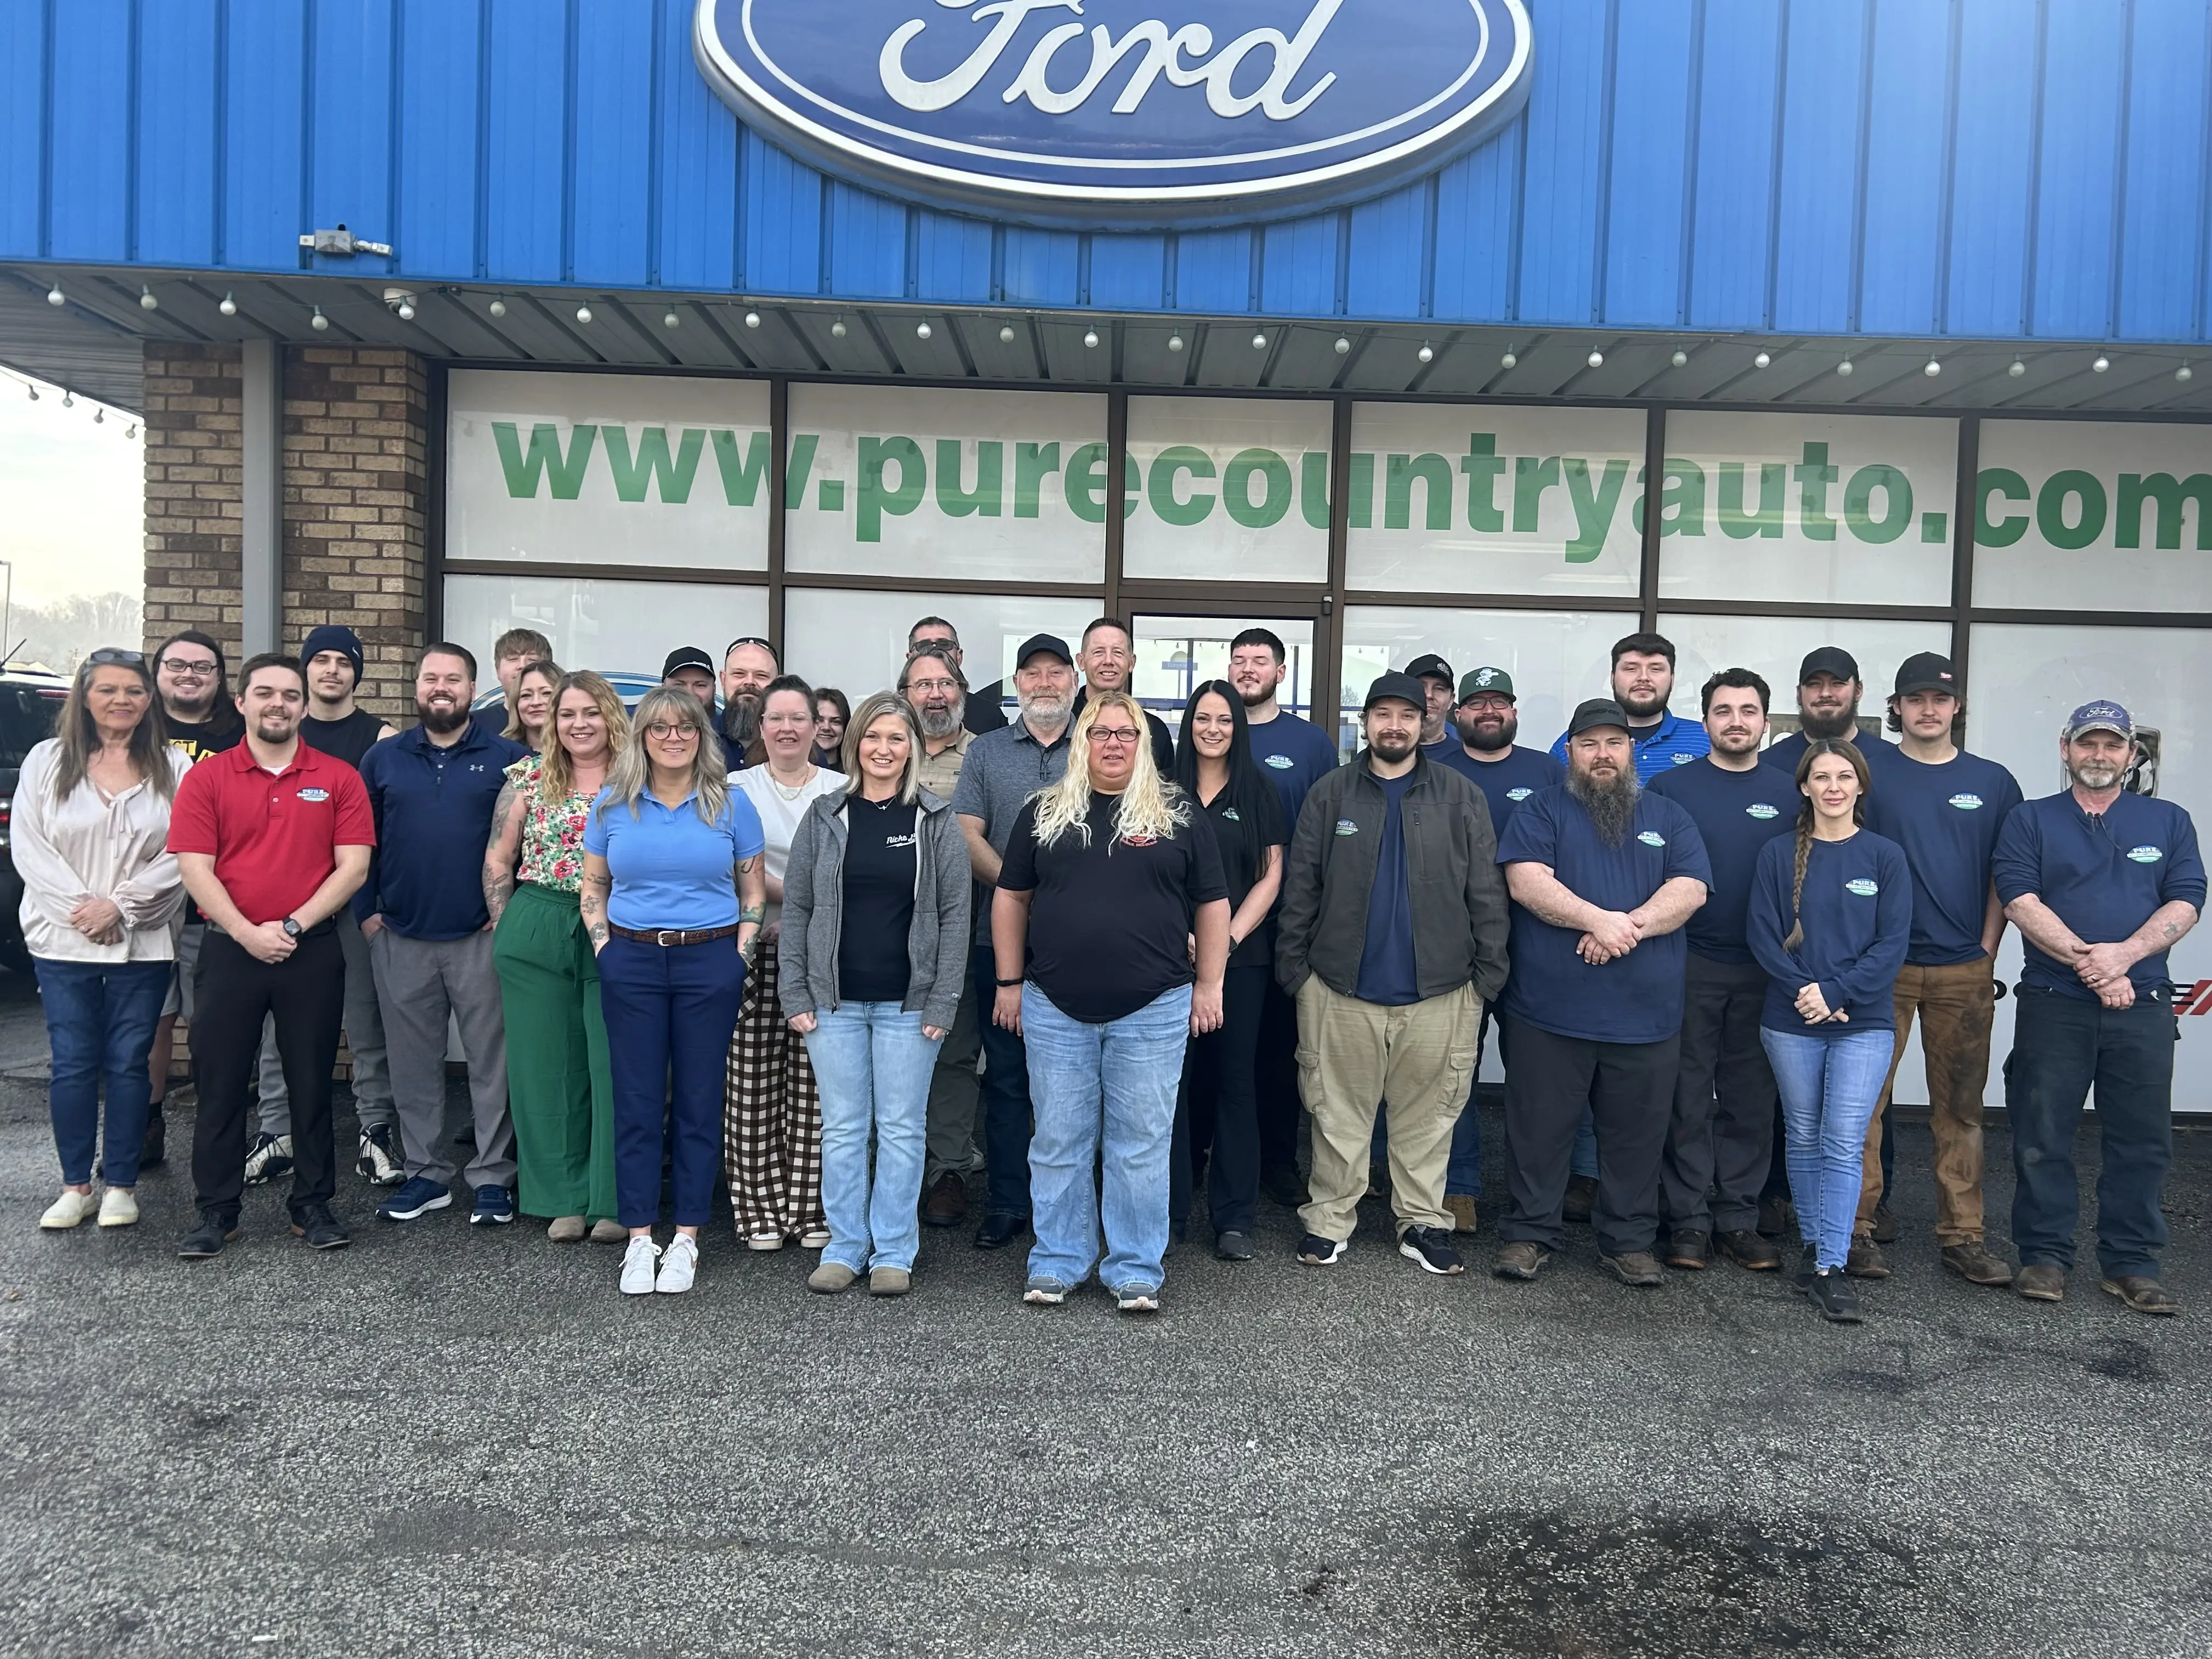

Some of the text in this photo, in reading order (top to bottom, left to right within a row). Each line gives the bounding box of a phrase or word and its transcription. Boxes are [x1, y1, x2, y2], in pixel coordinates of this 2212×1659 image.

[879, 0, 1336, 121] Ford
[490, 421, 2212, 563] www.purecountryauto.com
[2086, 707, 2115, 718] Ford
